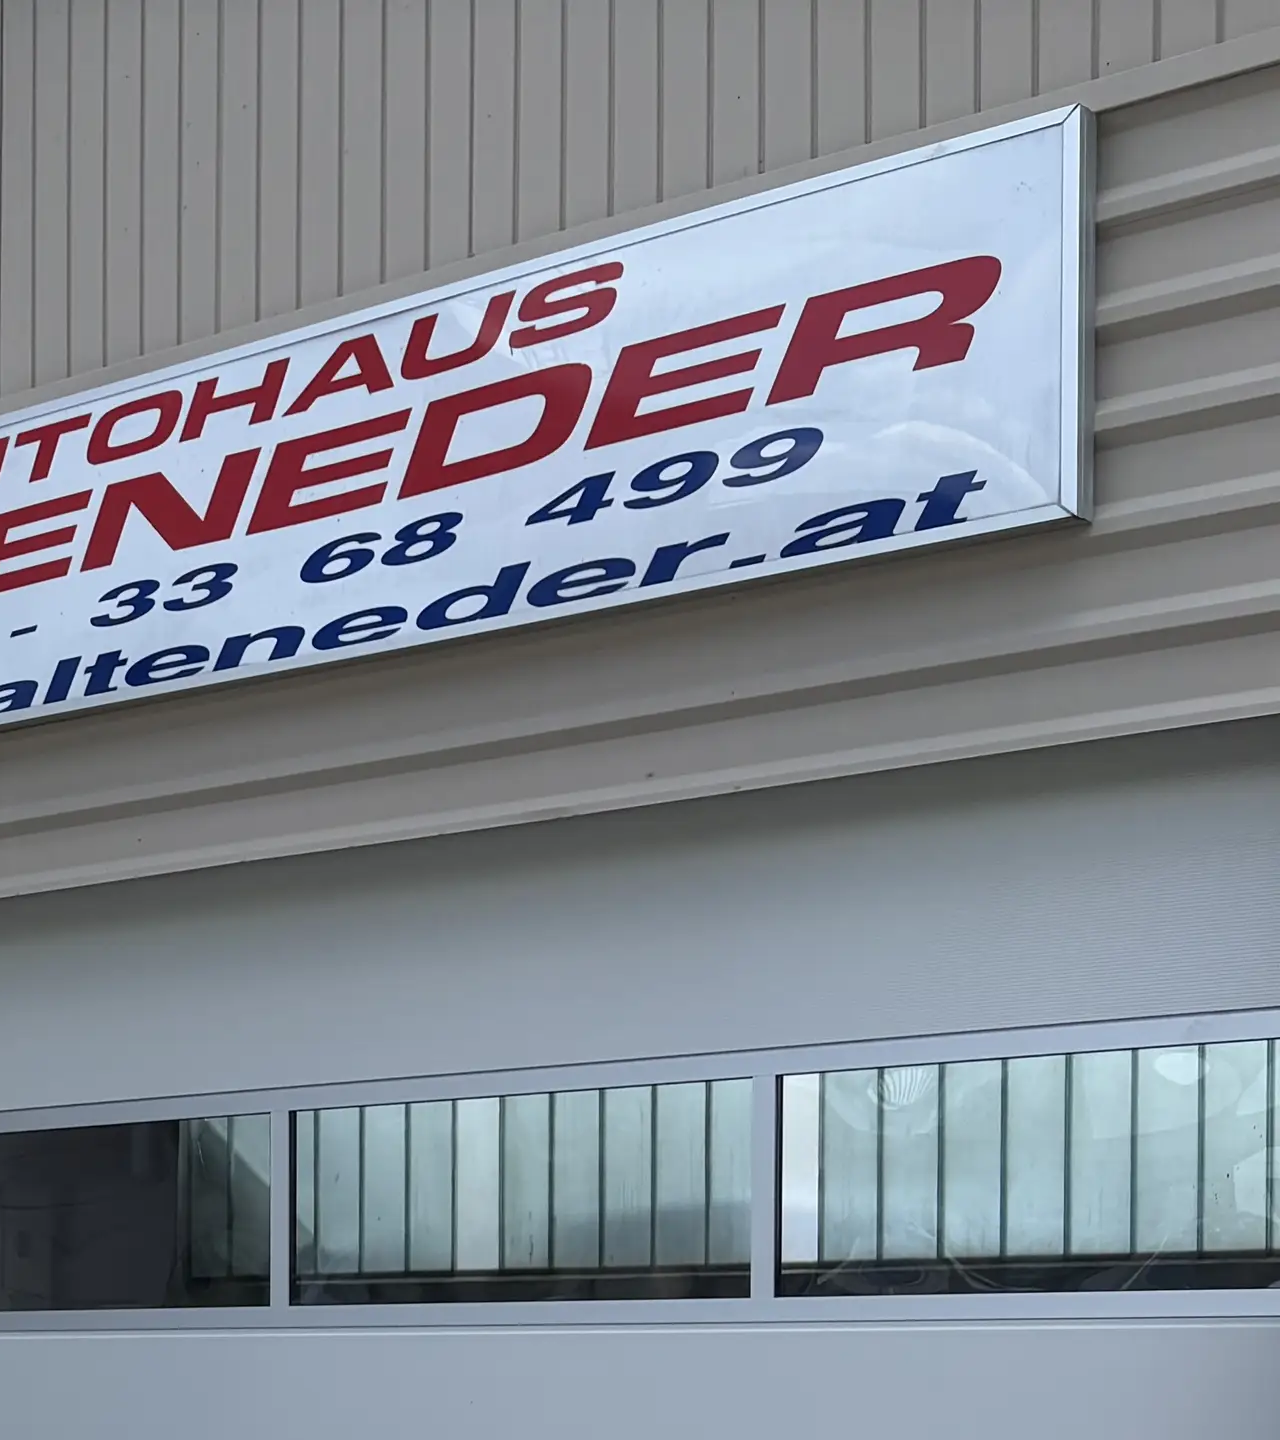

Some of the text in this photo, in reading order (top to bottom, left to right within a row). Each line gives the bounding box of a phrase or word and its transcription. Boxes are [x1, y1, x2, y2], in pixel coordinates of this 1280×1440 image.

[9, 624, 38, 639] -
[90, 562, 239, 628] 33
[300, 512, 464, 584] 68
[525, 427, 824, 527] 499
